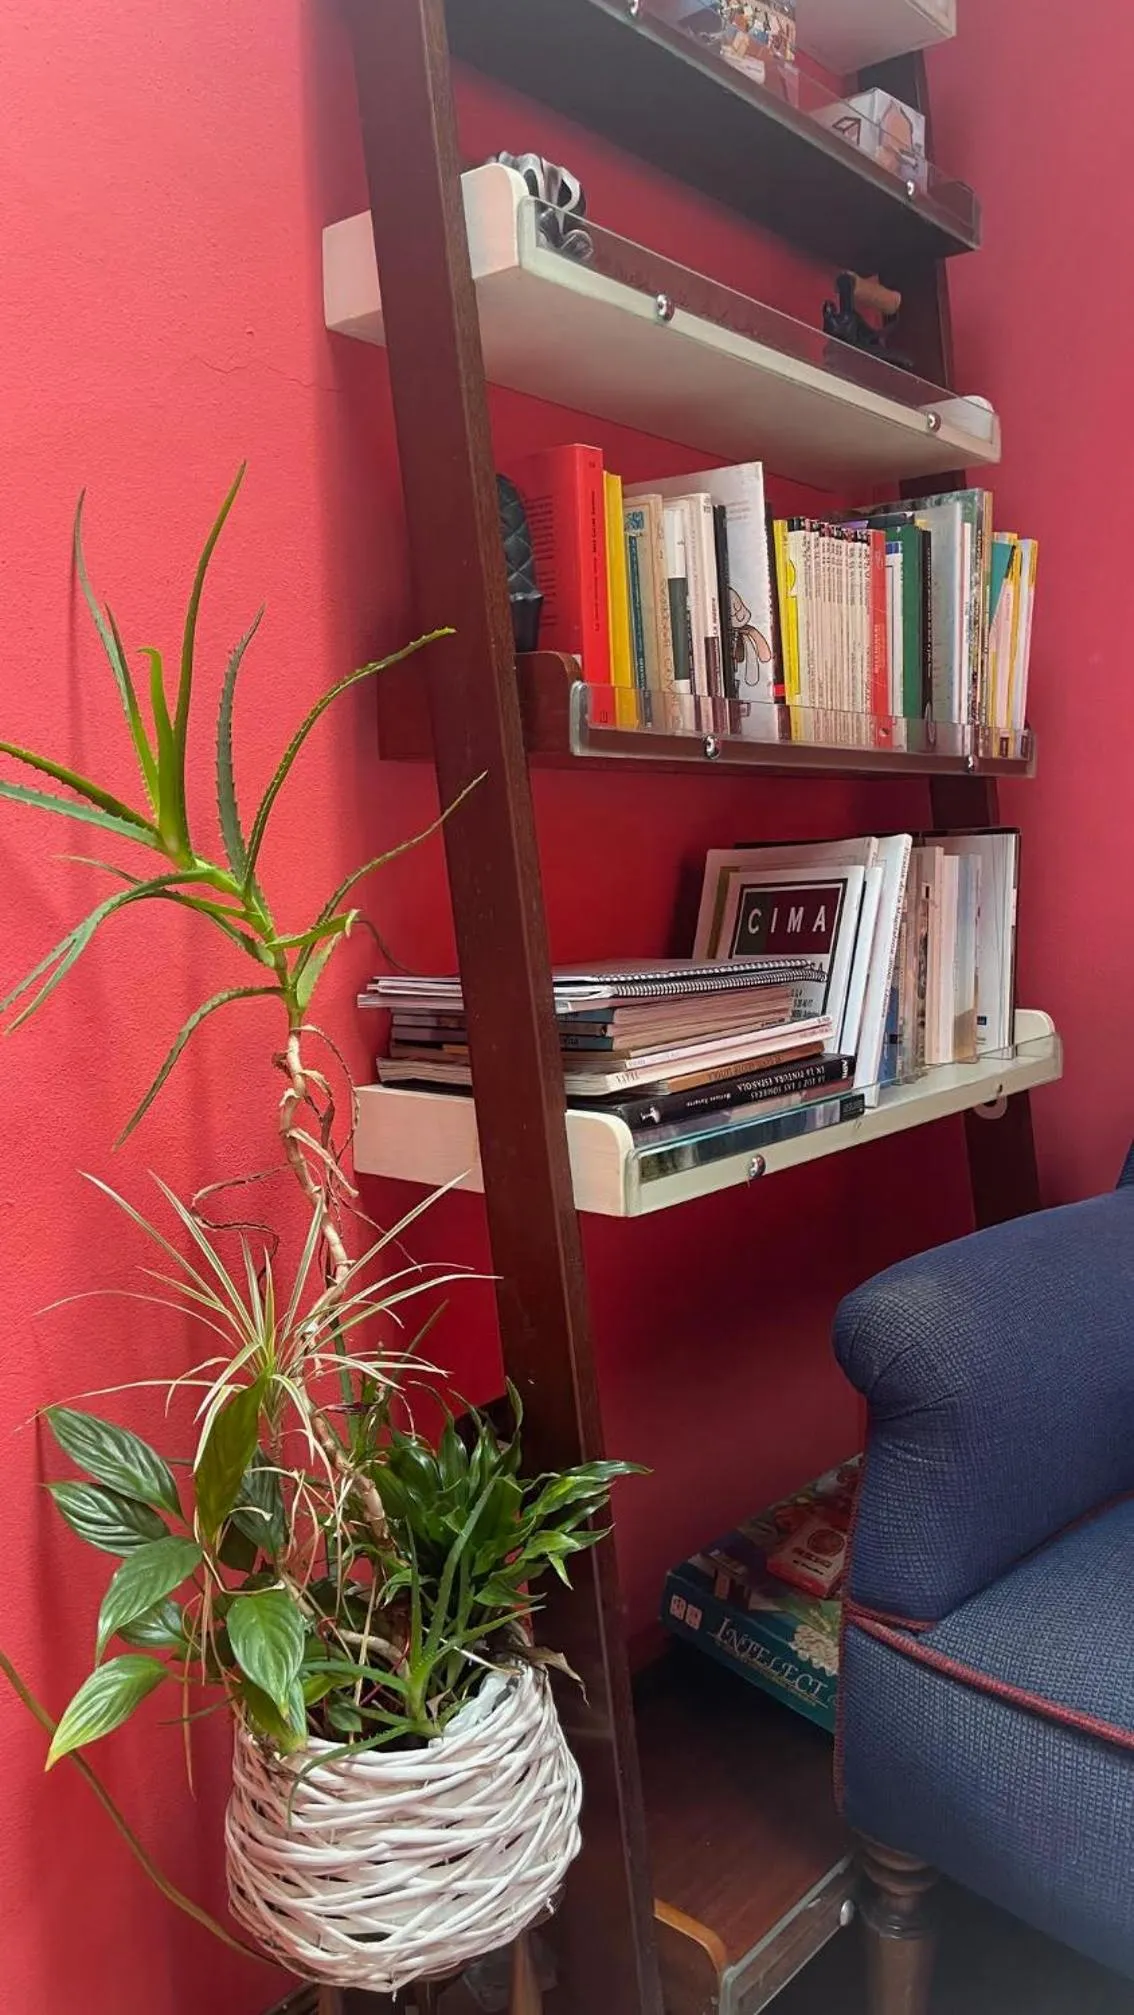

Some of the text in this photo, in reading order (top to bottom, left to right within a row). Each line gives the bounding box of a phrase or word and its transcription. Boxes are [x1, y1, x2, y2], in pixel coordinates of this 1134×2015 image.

[747, 904, 827, 935] CIMA
[736, 1076, 772, 1093] ESPAÑOLA
[774, 1070, 804, 1084] PINTURA
[803, 1077, 816, 1088] LUZ
[784, 1081, 795, 1093] LAS
[715, 1616, 829, 1699] INTELECT
